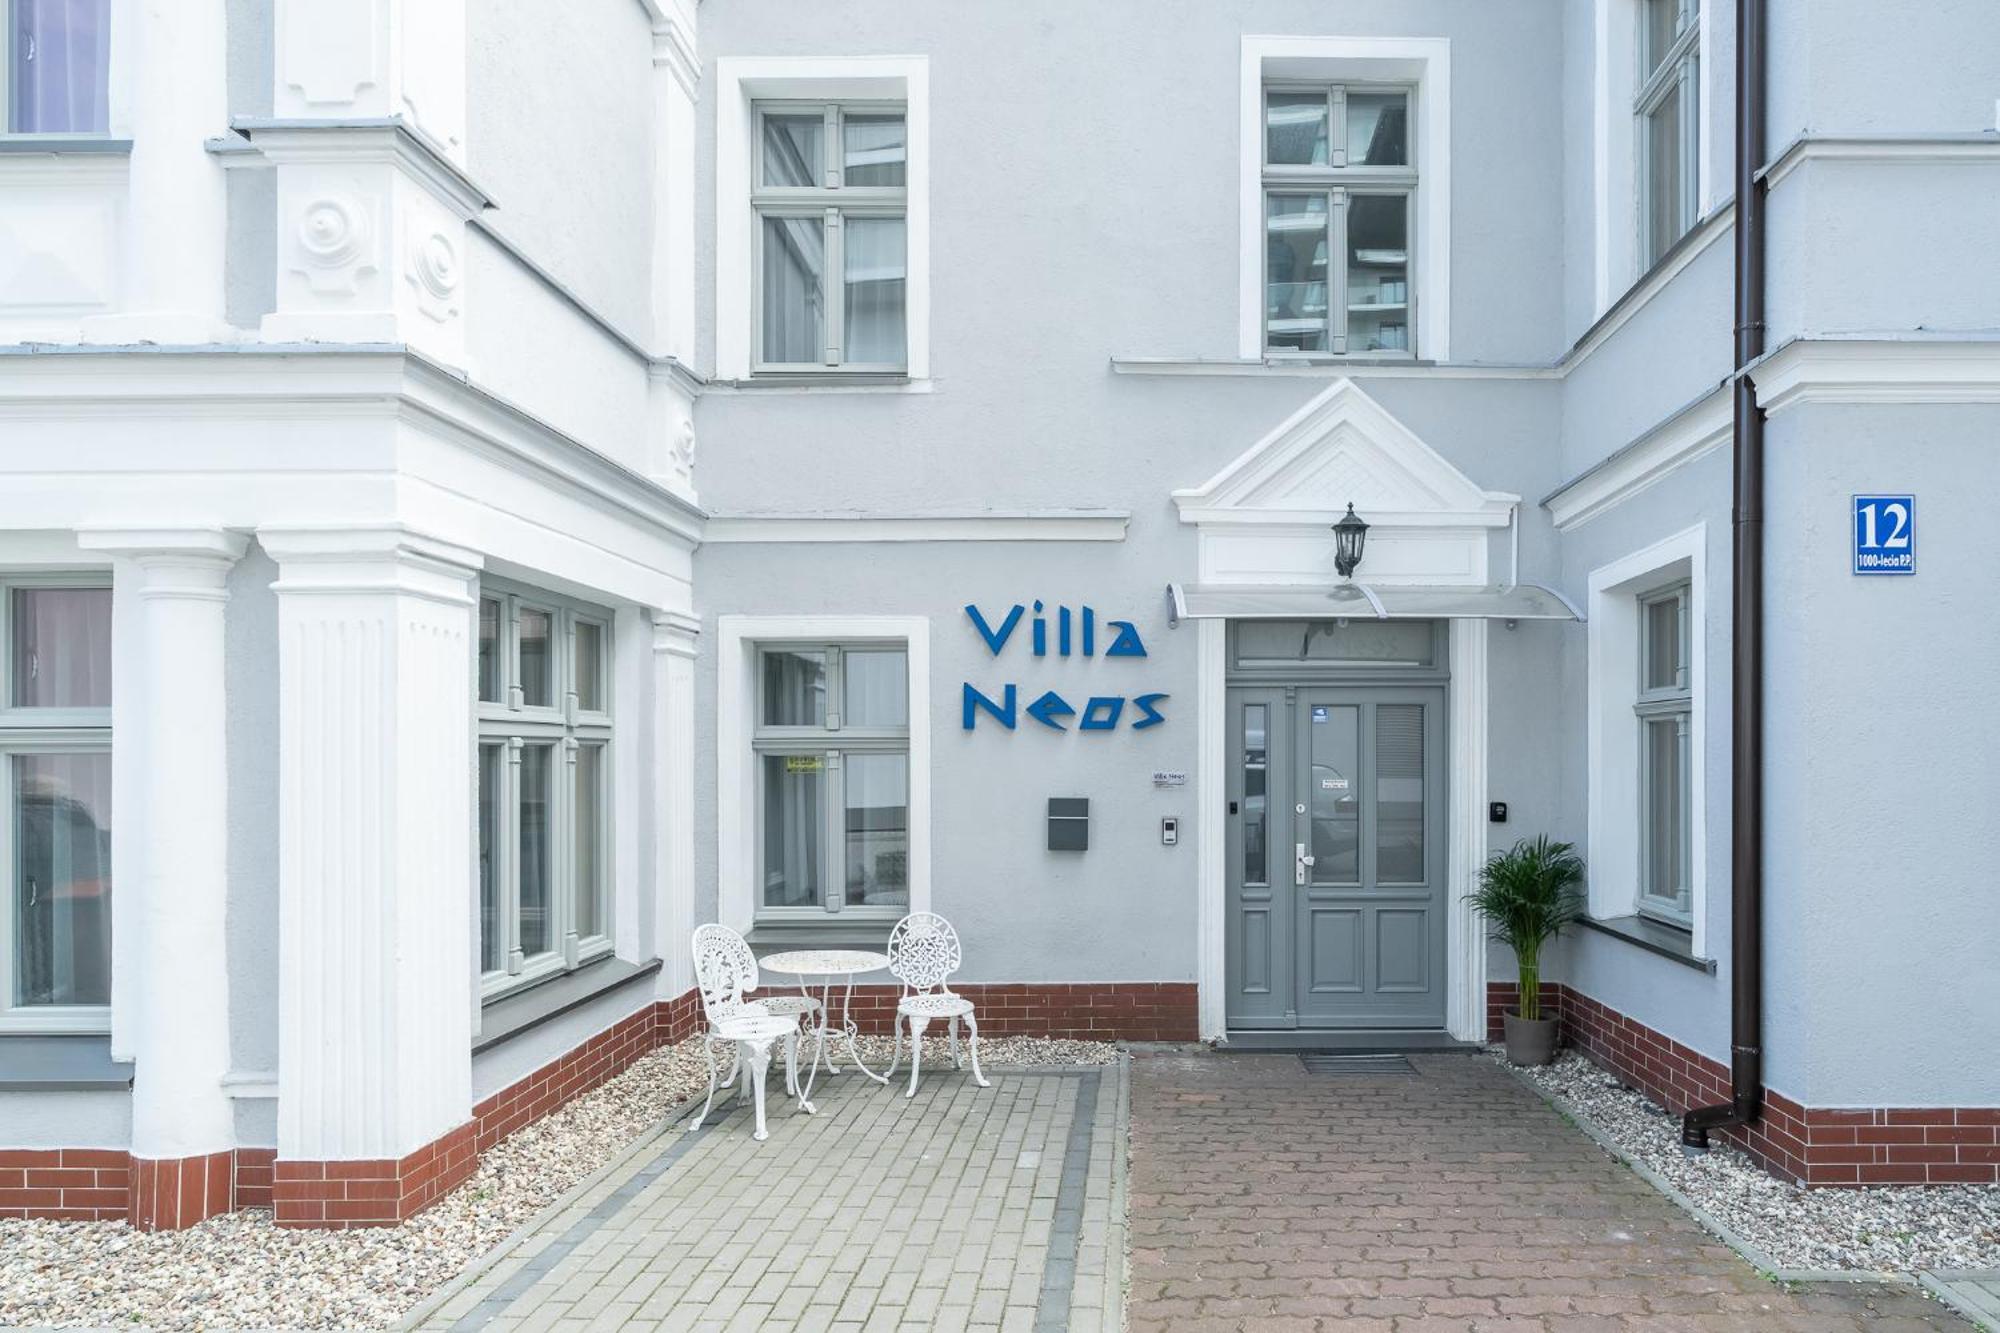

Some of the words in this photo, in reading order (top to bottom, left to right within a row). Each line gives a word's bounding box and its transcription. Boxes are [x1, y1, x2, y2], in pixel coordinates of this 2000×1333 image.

[1859, 503, 1909, 548] 12
[1859, 553, 1899, 567] 1000-lecia
[964, 600, 1148, 657] Villa
[962, 682, 1171, 731] Neos
